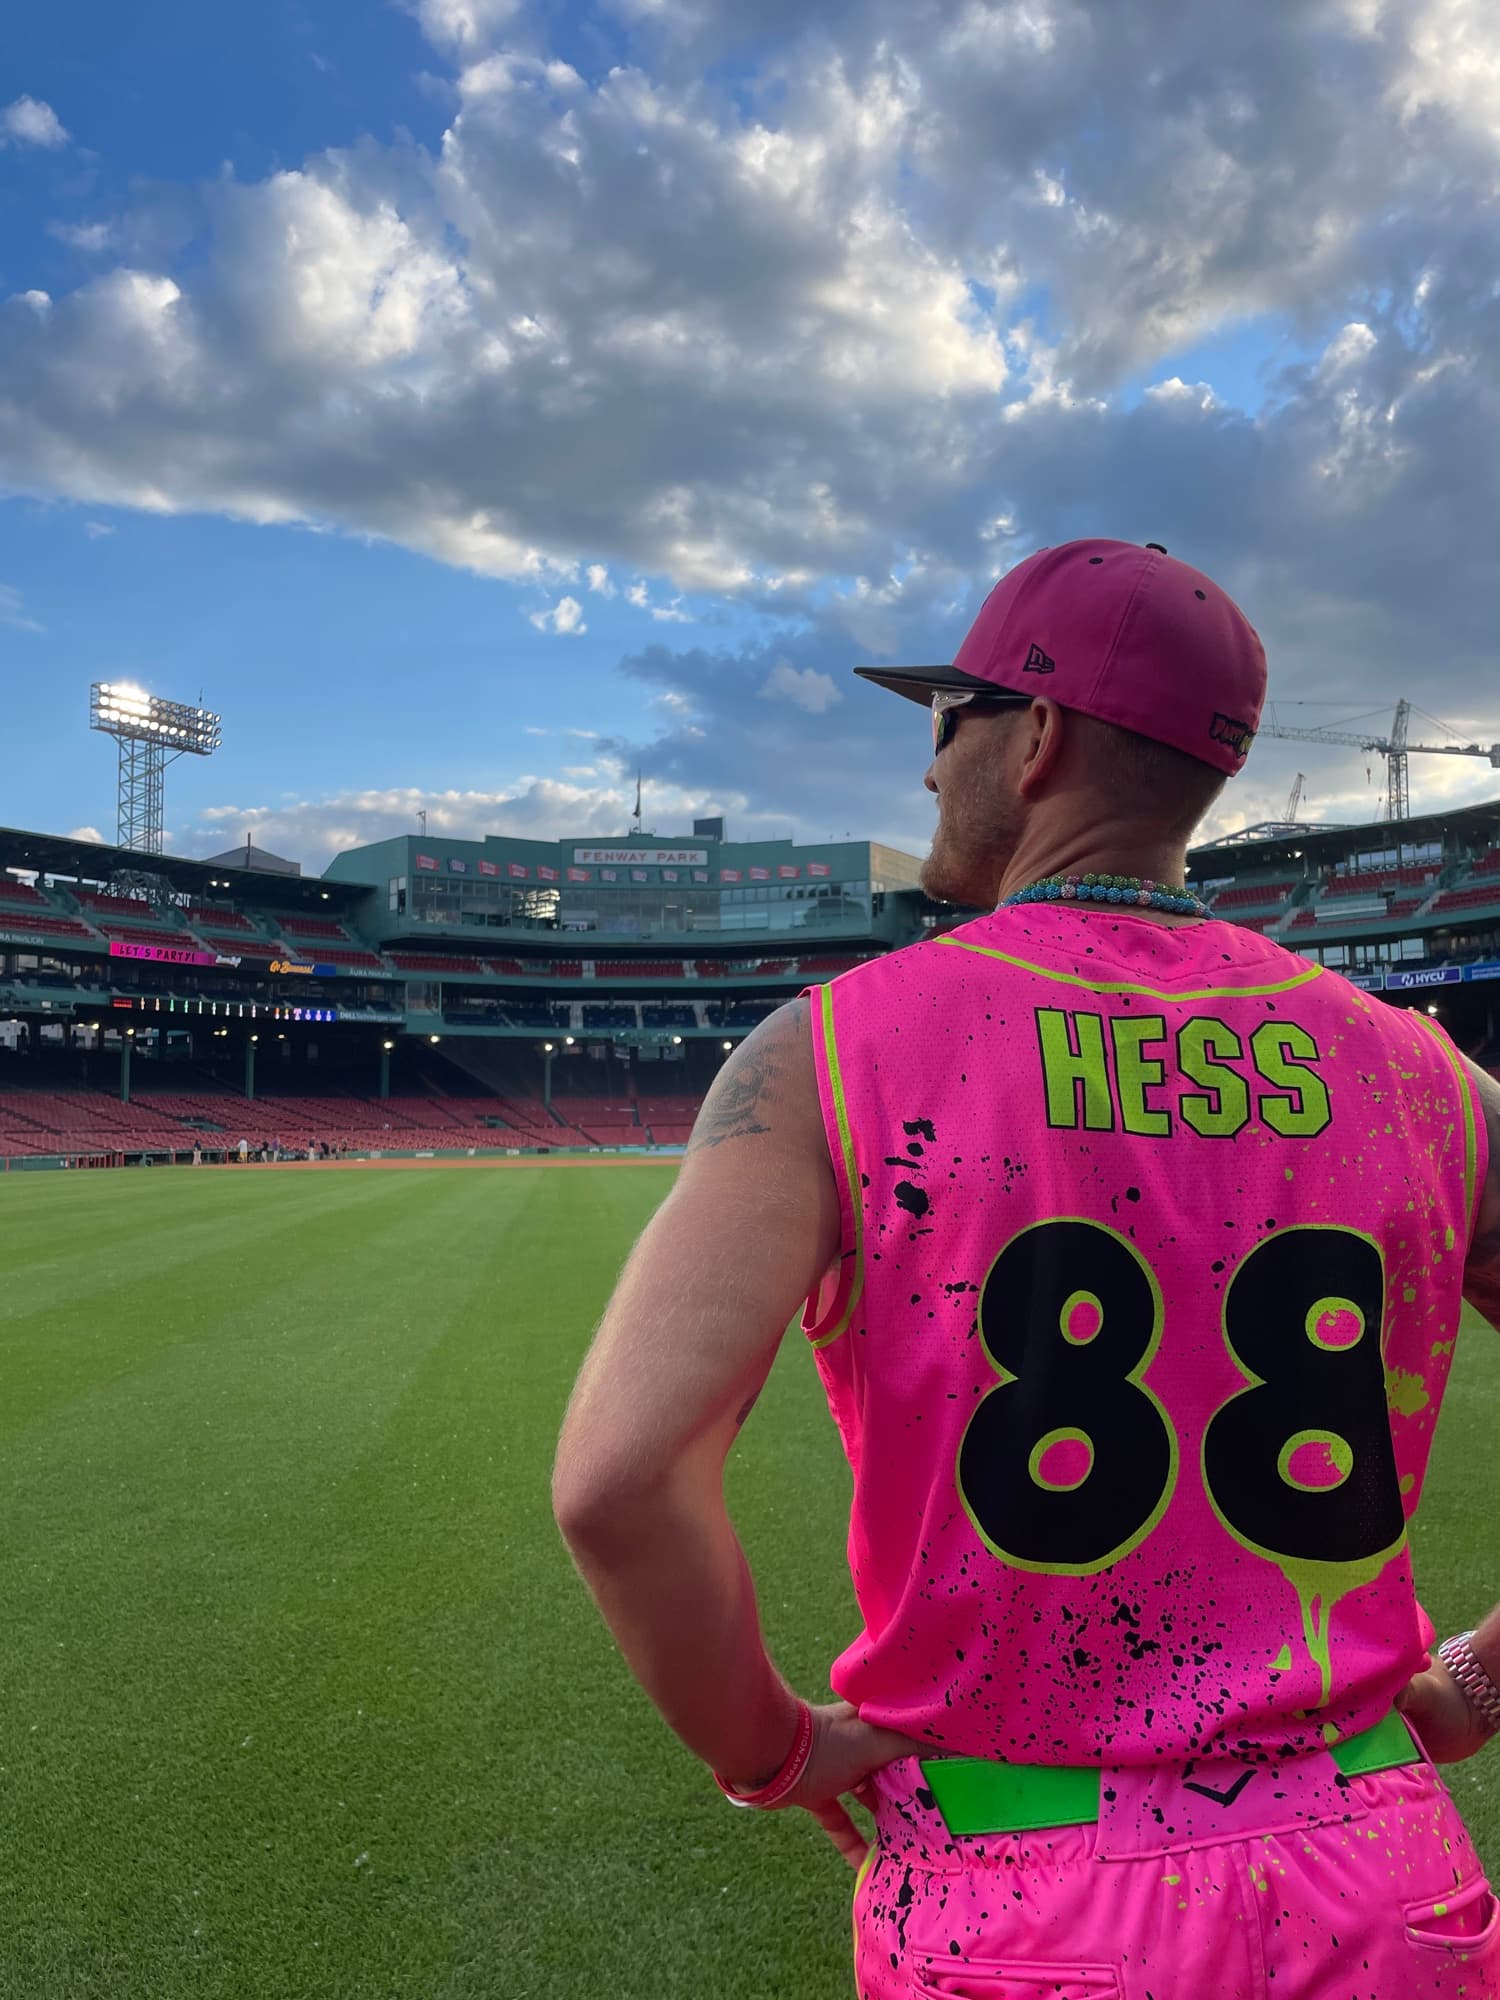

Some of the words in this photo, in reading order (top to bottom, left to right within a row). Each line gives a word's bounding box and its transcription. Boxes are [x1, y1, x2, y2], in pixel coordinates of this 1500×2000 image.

[582, 851, 647, 862] FENWAY
[656, 852, 699, 863] PARK
[119, 945, 151, 958] LET'S
[156, 949, 195, 963] PARTY!
[1415, 971, 1446, 985] HYCU
[1034, 1007, 1333, 1139] HESS
[955, 1215, 1407, 1577] 88
